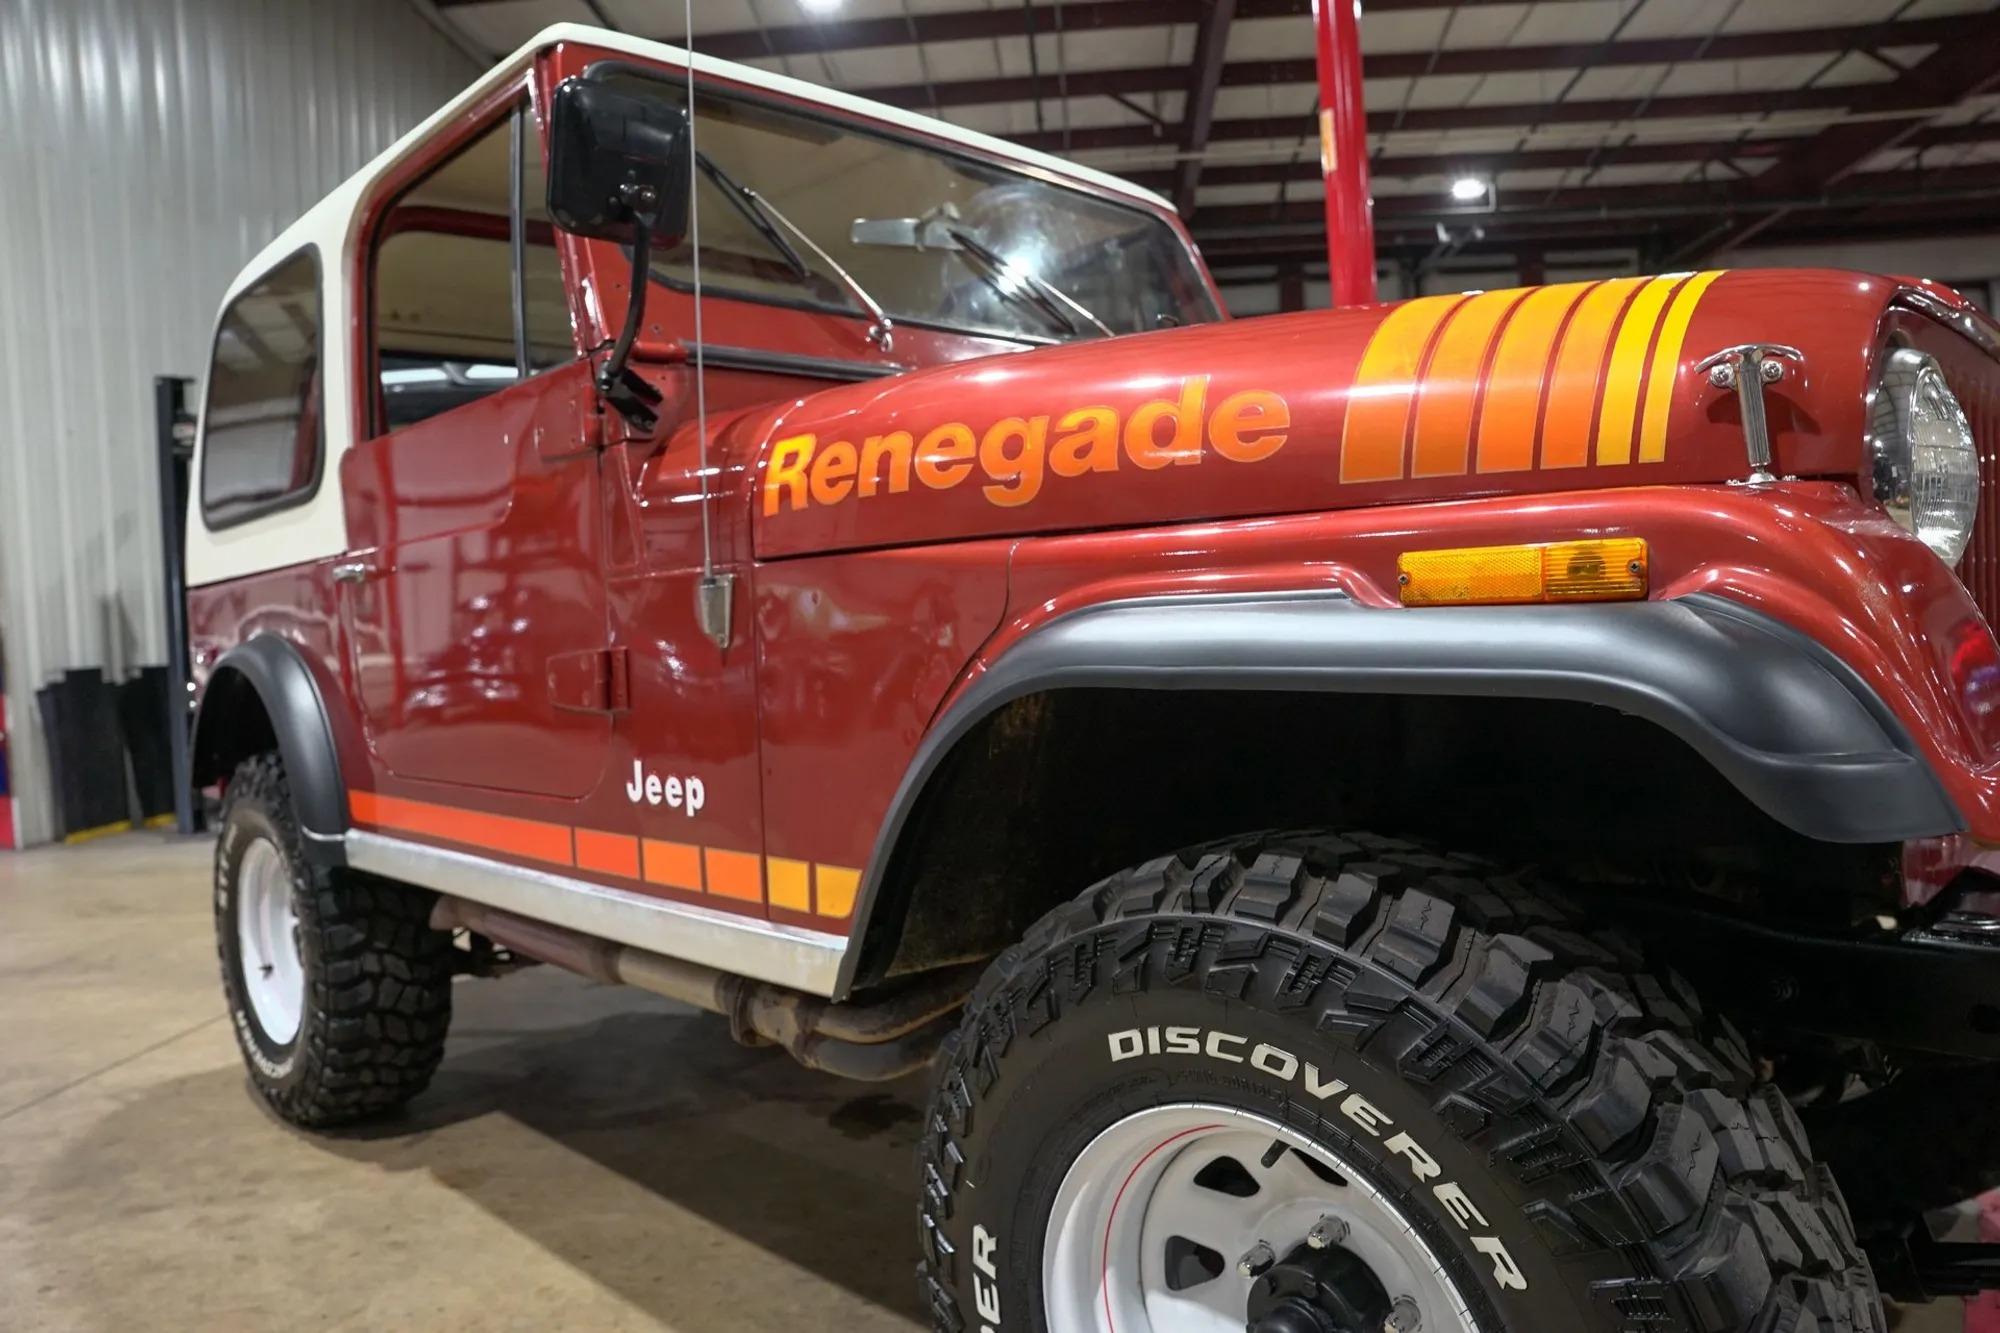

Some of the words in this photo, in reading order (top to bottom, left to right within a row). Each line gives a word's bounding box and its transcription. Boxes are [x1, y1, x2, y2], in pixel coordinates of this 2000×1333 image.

[763, 374, 1290, 516] Renegade
[626, 759, 705, 817] Jeep
[1108, 1026, 1528, 1290] DISCOVERER
[973, 1224, 1001, 1333] ER
